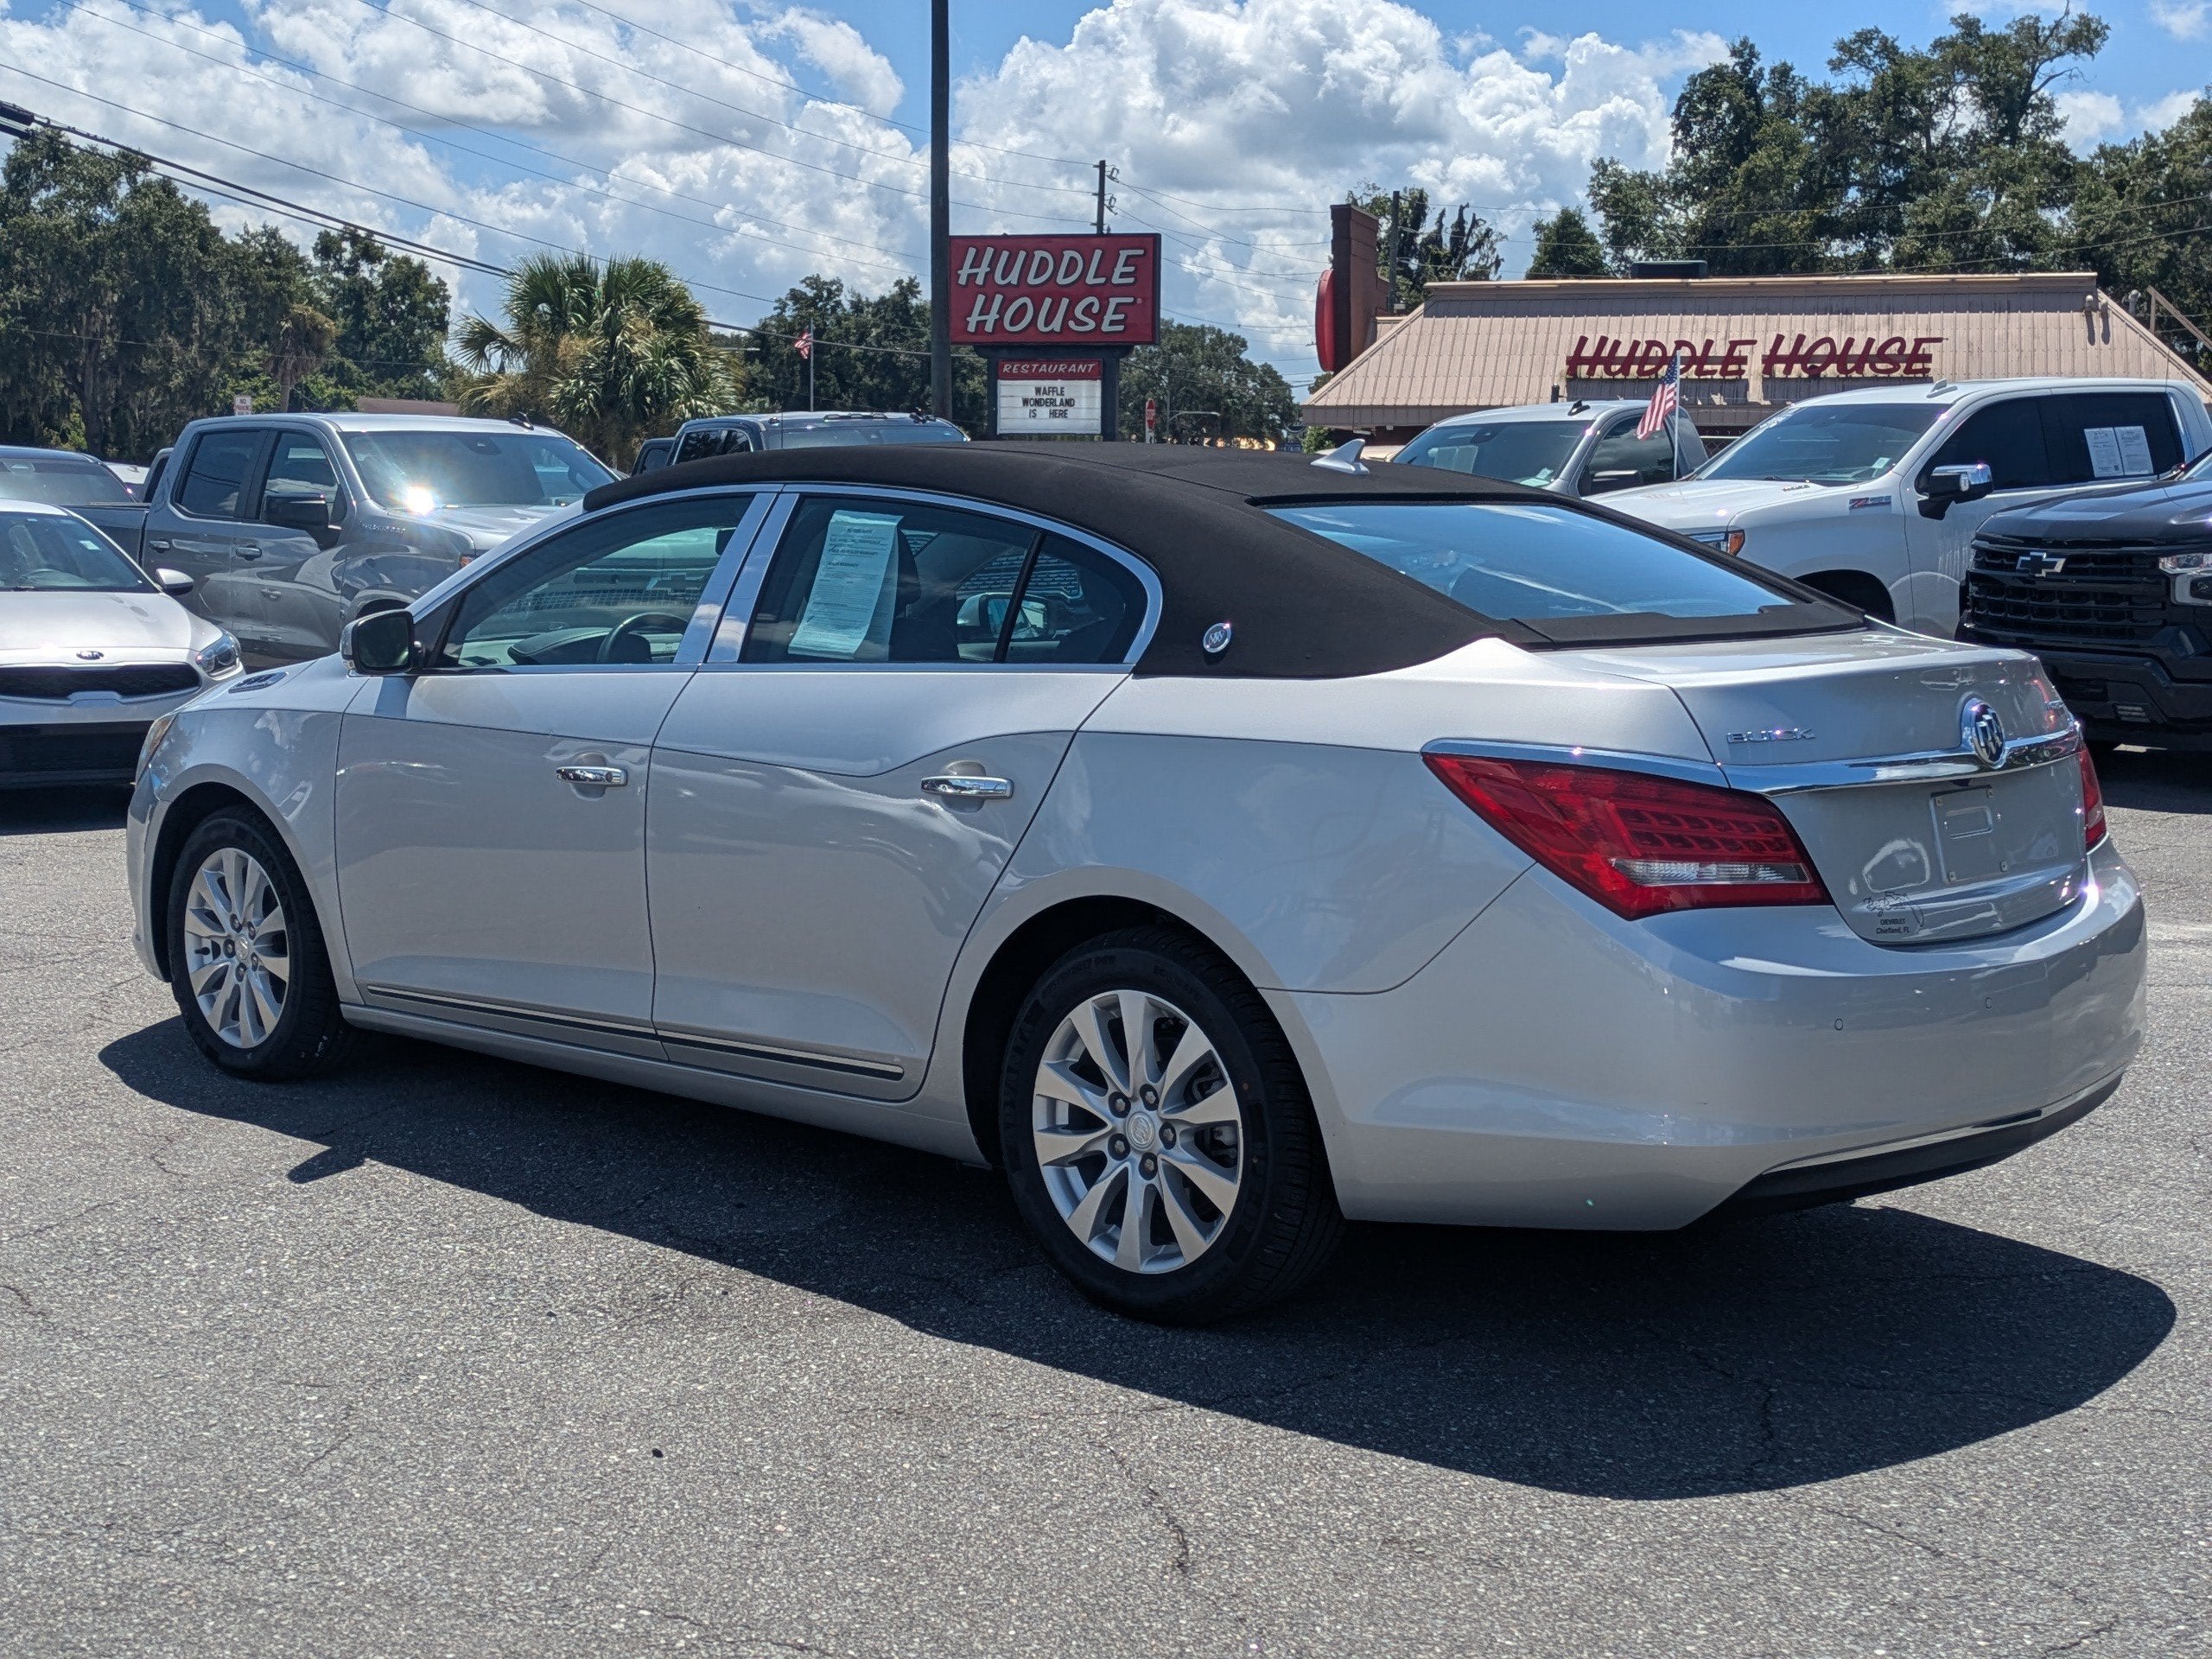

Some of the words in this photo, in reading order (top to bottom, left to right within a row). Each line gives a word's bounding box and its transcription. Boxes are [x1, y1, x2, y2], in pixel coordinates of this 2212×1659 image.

[957, 245, 1146, 287] HUDDLE
[965, 293, 1135, 334] HOUSE
[1566, 334, 1758, 378] HUDDLE
[1761, 333, 1944, 378] HOUSE
[1002, 363, 1096, 374] RESTAURANT
[1034, 385, 1065, 397] WAFFLE
[1021, 397, 1076, 408] WONDERLAND
[1028, 409, 1038, 419] IS
[1048, 409, 1069, 419] HERE
[1726, 728, 1817, 744] BUICK
